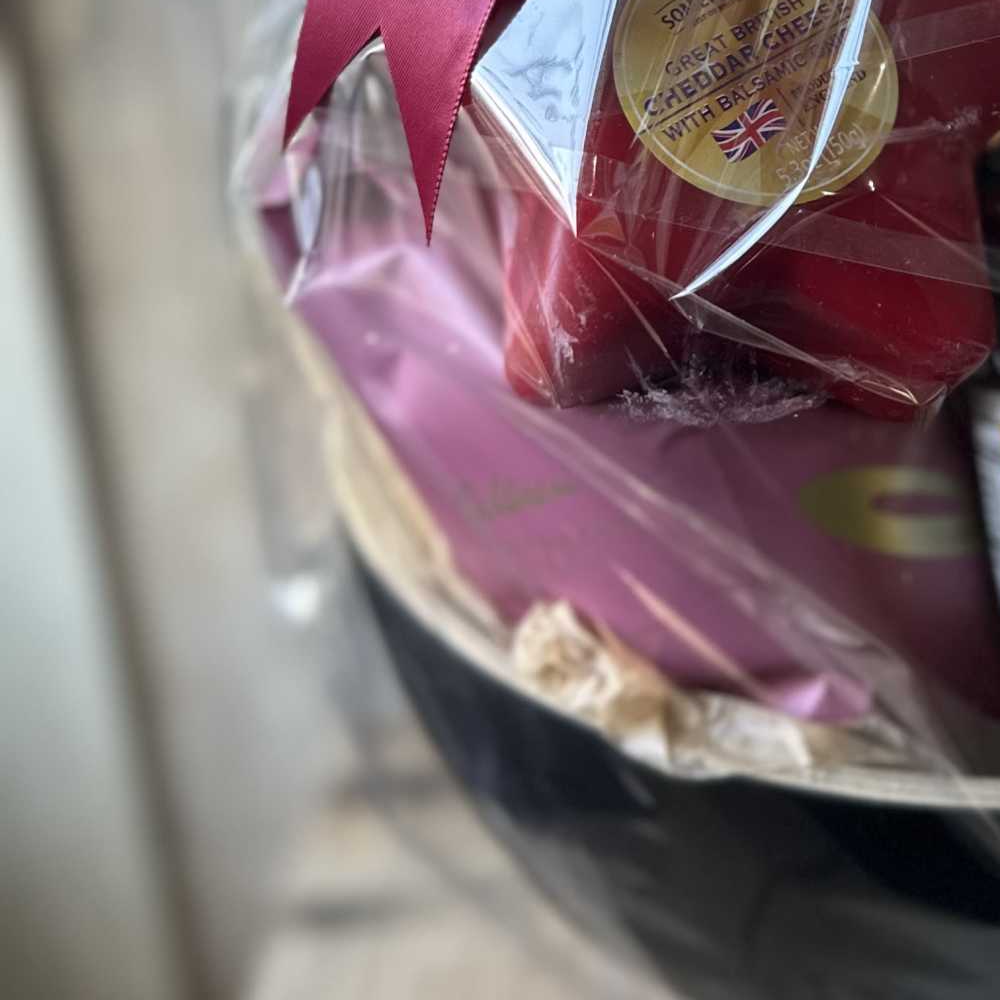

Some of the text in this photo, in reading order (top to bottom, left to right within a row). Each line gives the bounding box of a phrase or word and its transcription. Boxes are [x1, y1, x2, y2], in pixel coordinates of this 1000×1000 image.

[643, 44, 760, 117] CHEDDAR
[665, 34, 729, 77] GREAT
[662, 52, 808, 142] WITH BALSAMIC
